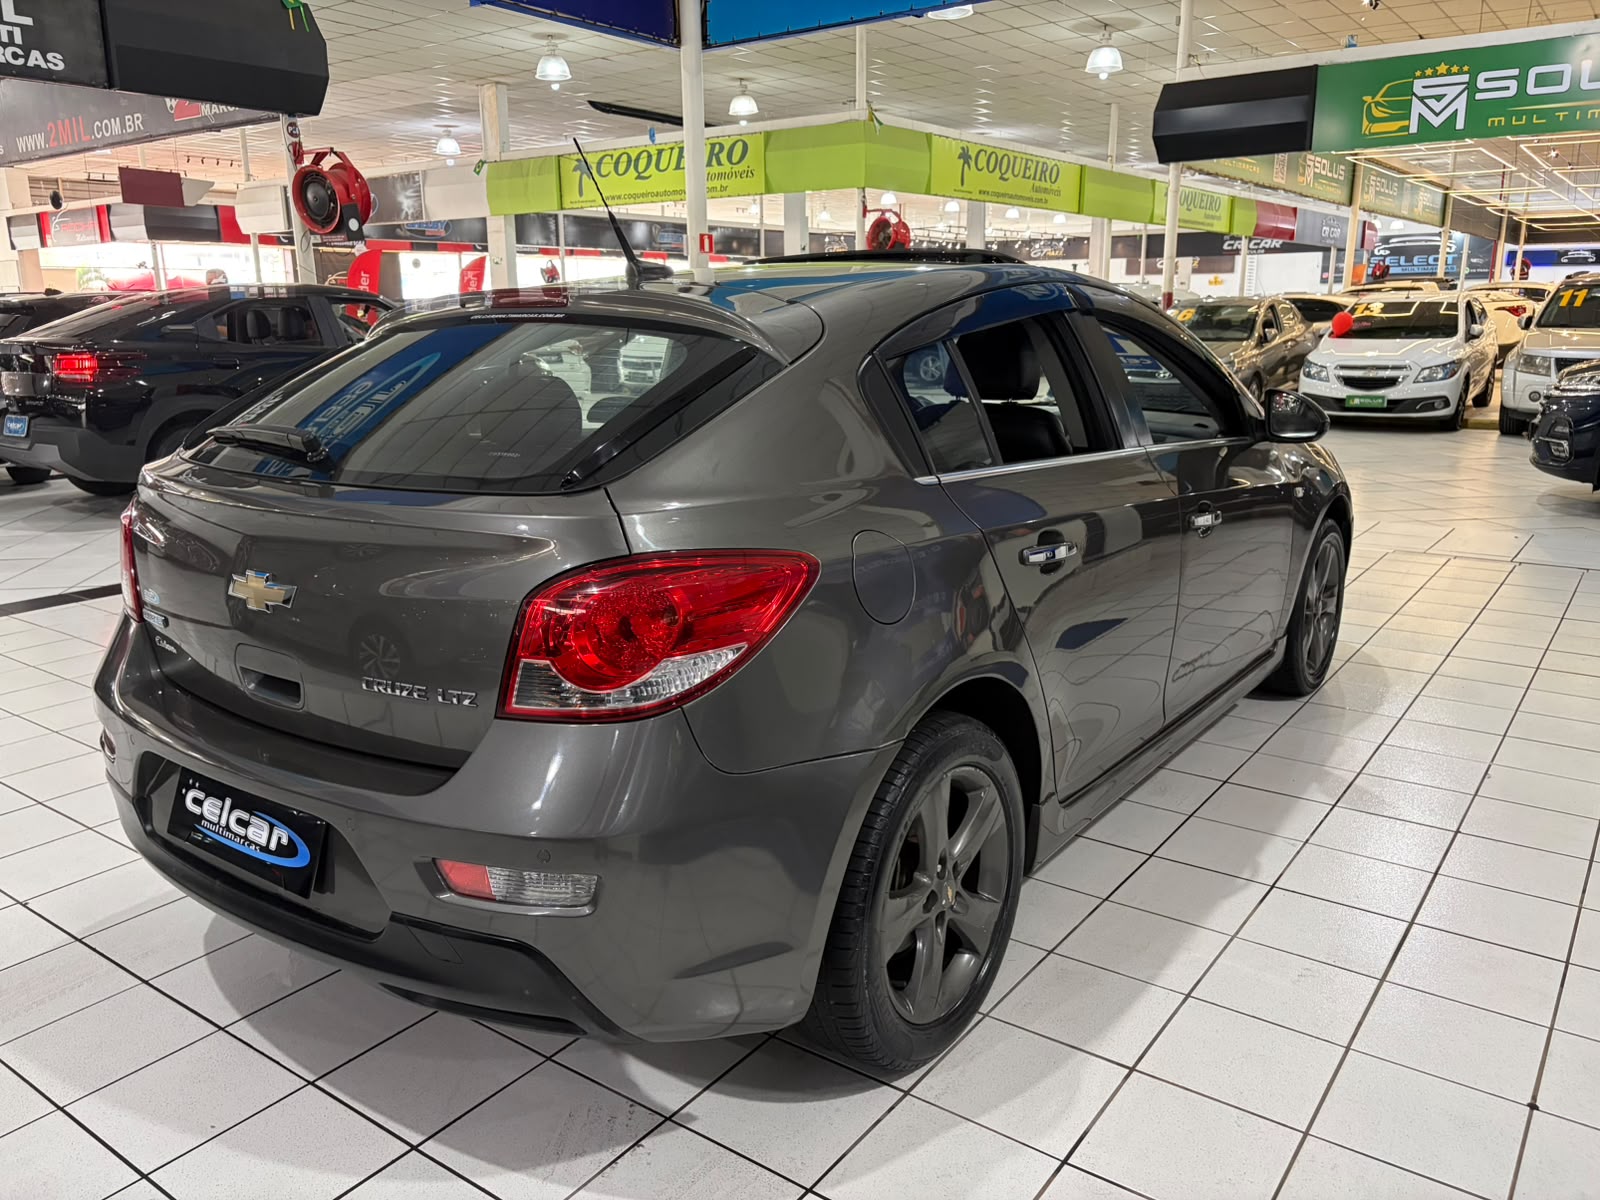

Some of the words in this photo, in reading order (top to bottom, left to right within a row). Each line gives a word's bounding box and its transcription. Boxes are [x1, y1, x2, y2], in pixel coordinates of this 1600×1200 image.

[16, 113, 145, 153] WWW.2MIL.COM.BR
[596, 138, 749, 181] COQUERO
[705, 164, 756, 182] tomóveis
[974, 148, 1060, 185] COQUEIRO
[1314, 156, 1346, 181] SOLUS
[1180, 187, 1222, 213] OQUEIRO
[1249, 239, 1283, 250] CAR
[1558, 288, 1589, 308] 11
[361, 676, 429, 701] CRUZE
[436, 688, 479, 708] LTZ
[201, 818, 262, 854] multimarcas
